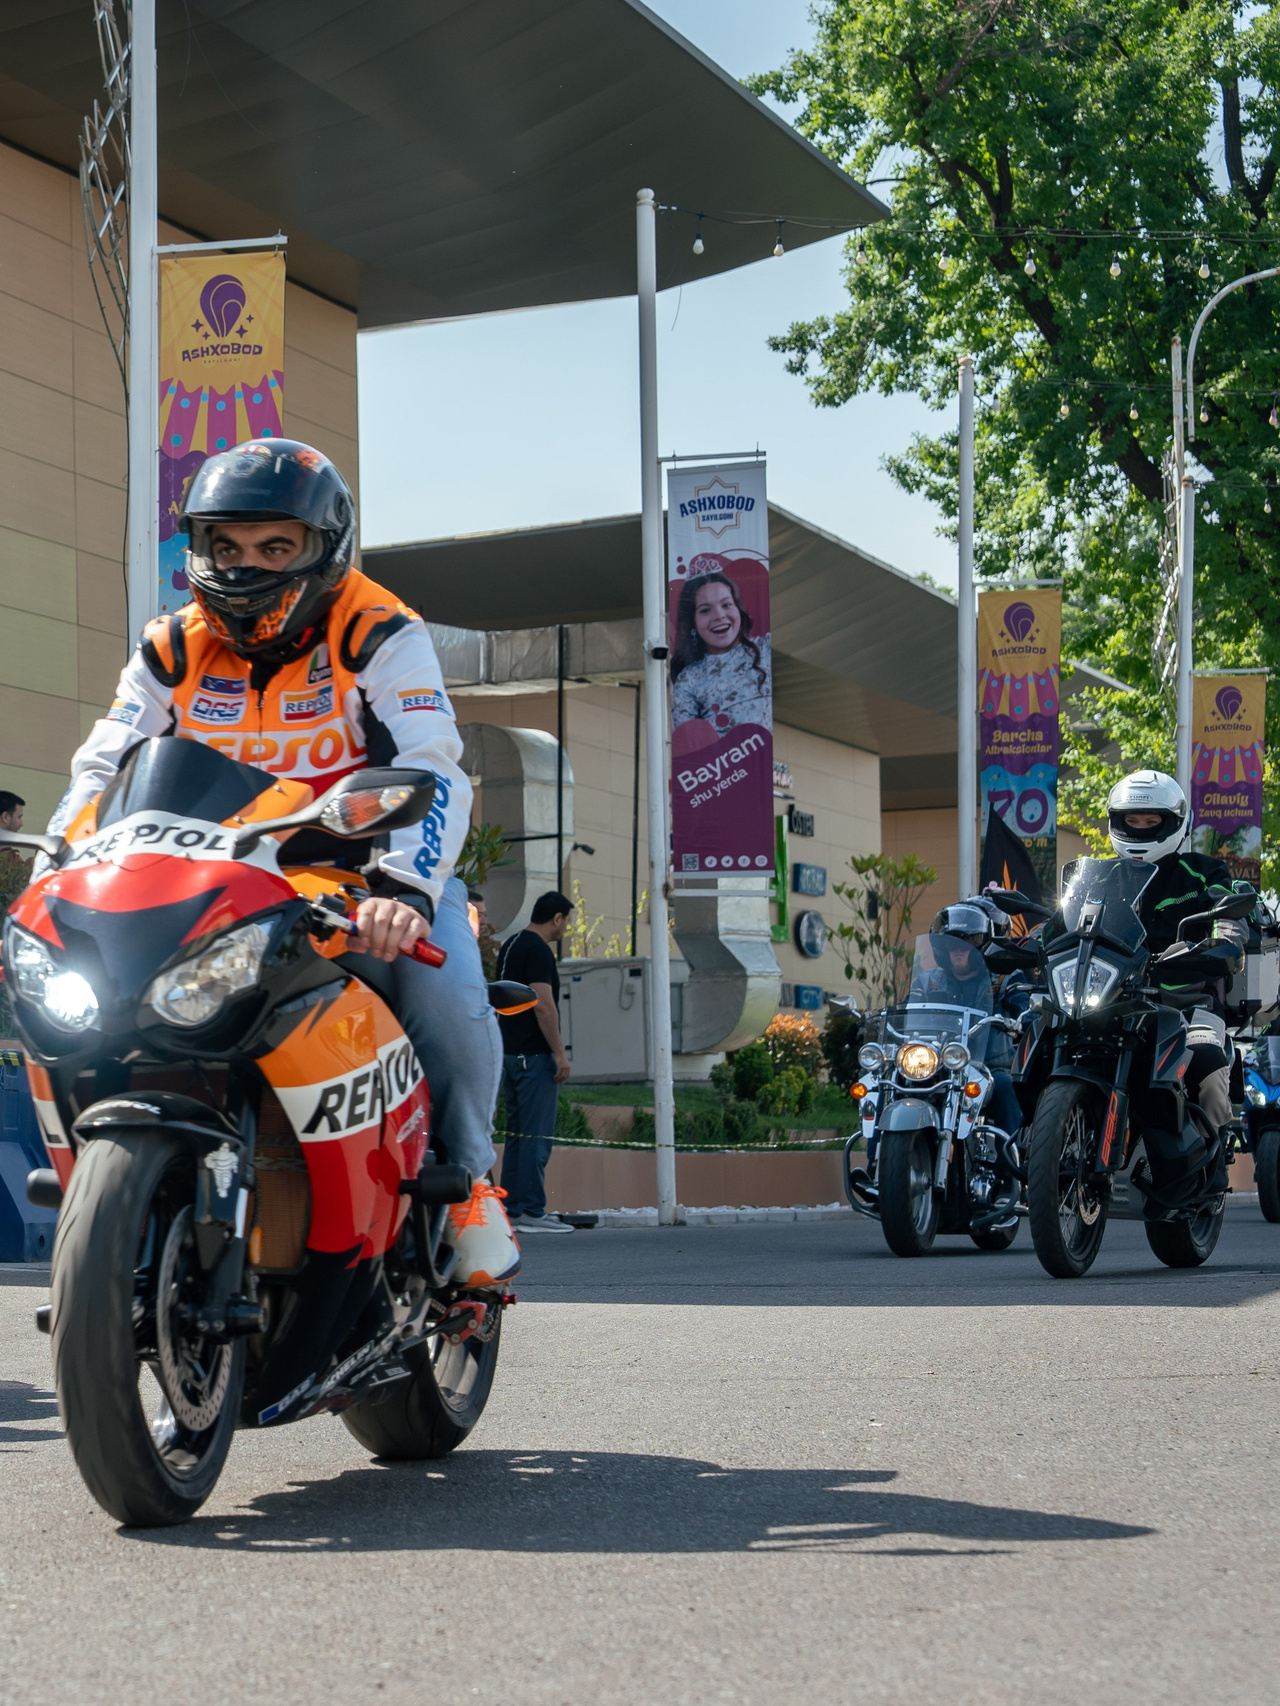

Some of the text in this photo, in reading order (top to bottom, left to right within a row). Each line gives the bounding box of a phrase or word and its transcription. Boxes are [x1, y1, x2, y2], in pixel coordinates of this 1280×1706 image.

[181, 342, 263, 362] ASHXOBOD
[679, 495, 755, 518] ASHXOBOD
[991, 645, 1047, 658] ASHXOBOD
[402, 695, 446, 708] REPSO
[1203, 722, 1252, 733] ASHXOBOD
[992, 729, 1044, 743] Barcha
[177, 724, 368, 773] EPSOL
[676, 733, 765, 793] Bayram
[689, 788, 713, 809] shu
[712, 768, 748, 796] yerda
[1198, 808, 1254, 819] Zavq uchun
[1021, 837, 1048, 848] o'm
